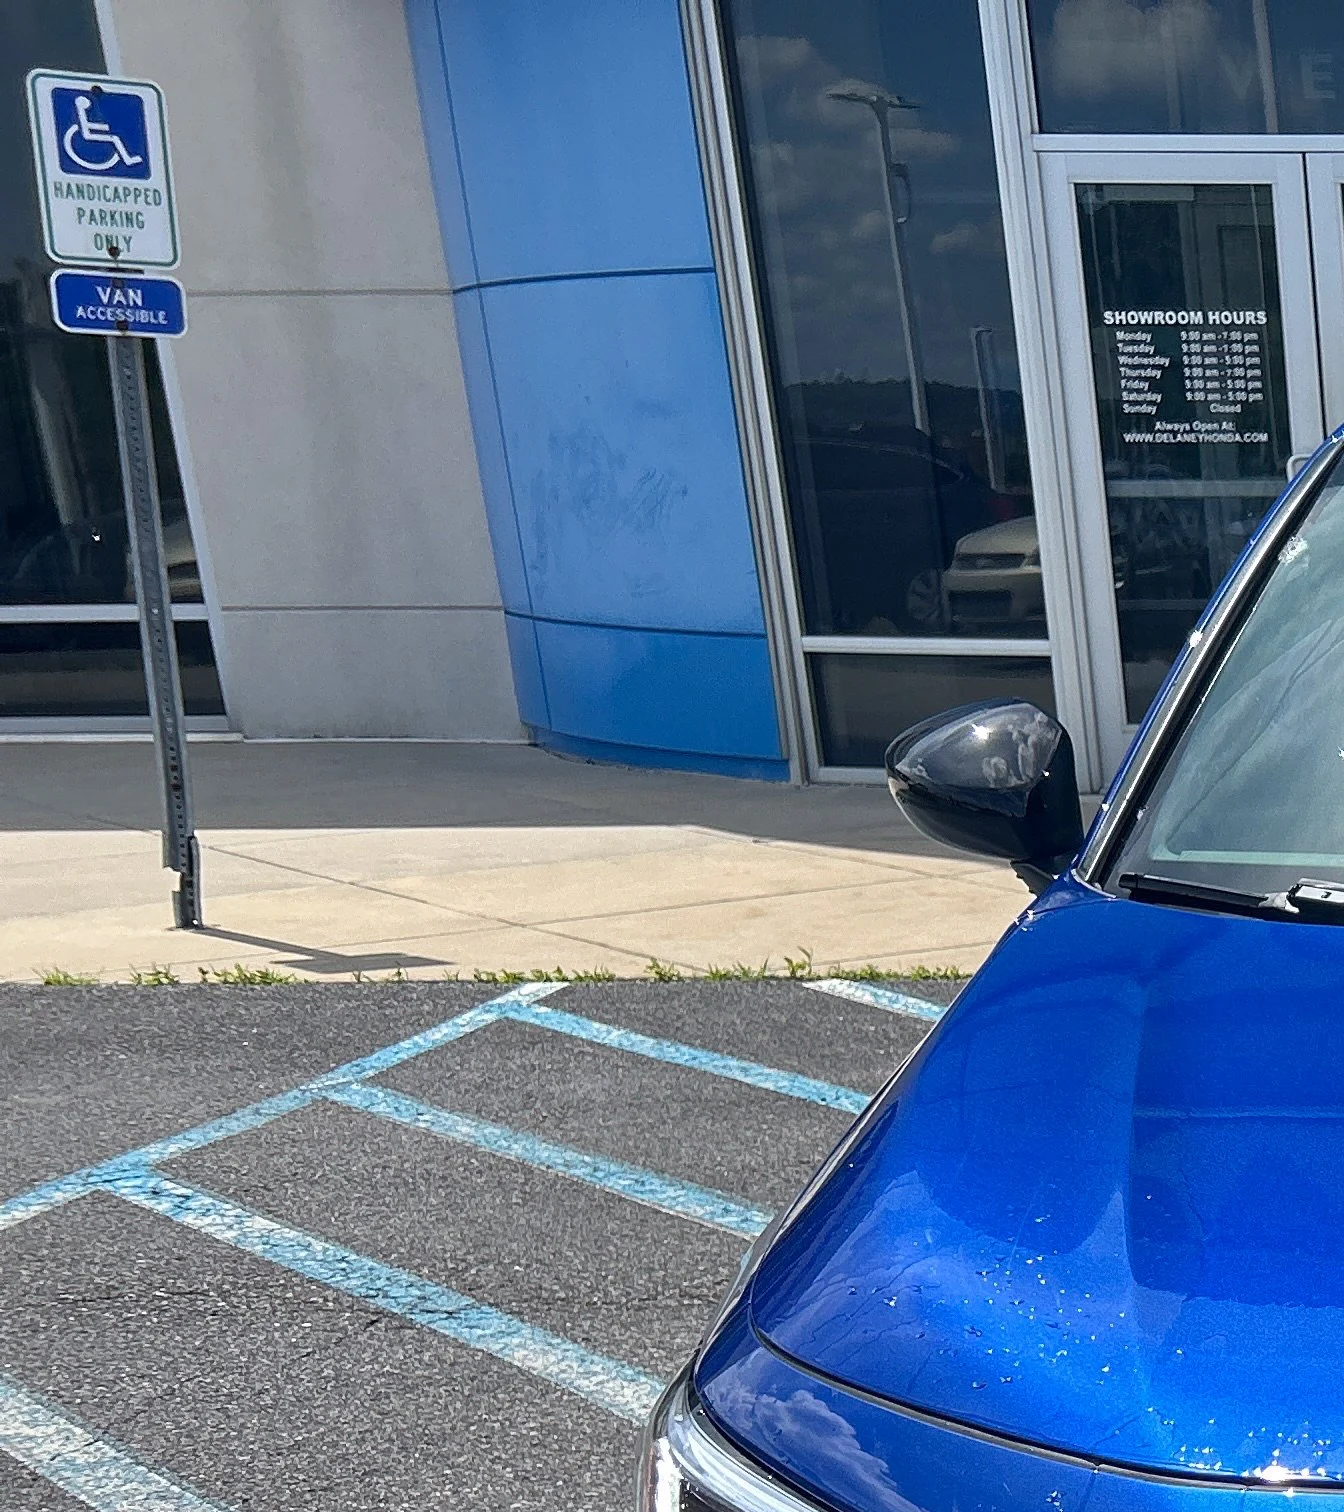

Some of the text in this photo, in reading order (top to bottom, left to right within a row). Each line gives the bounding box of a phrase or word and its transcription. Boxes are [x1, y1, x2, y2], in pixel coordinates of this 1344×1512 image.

[53, 180, 162, 207] HANDICAPPED
[76, 208, 145, 229] PARKING
[93, 232, 132, 253] ONLY
[95, 285, 143, 307] VAN
[75, 305, 168, 325] ACCESSIBLE
[1103, 310, 1268, 325] SHOWROOM HOURS
[1116, 331, 1152, 343] Monday
[1202, 333, 1216, 341] am
[1243, 333, 1259, 342] pm
[1117, 343, 1155, 354] Tuesday
[1244, 345, 1260, 354] pm
[1118, 355, 1170, 367] Wednesday
[1246, 357, 1260, 367] pm
[1119, 367, 1162, 379] Thursday
[1205, 369, 1219, 377] am
[1246, 369, 1261, 379] pm
[1121, 379, 1149, 391] Friday
[1206, 381, 1220, 389] am
[1247, 381, 1262, 391] pm
[1122, 391, 1162, 403] Saturday
[1207, 393, 1221, 401] am
[1248, 393, 1263, 403] pm
[1123, 403, 1241, 415] Sunday Closed
[1154, 421, 1191, 432] Always
[1192, 421, 1220, 432] Open
[1123, 432, 1268, 443] WWW.DELANEYHONDA.COM
